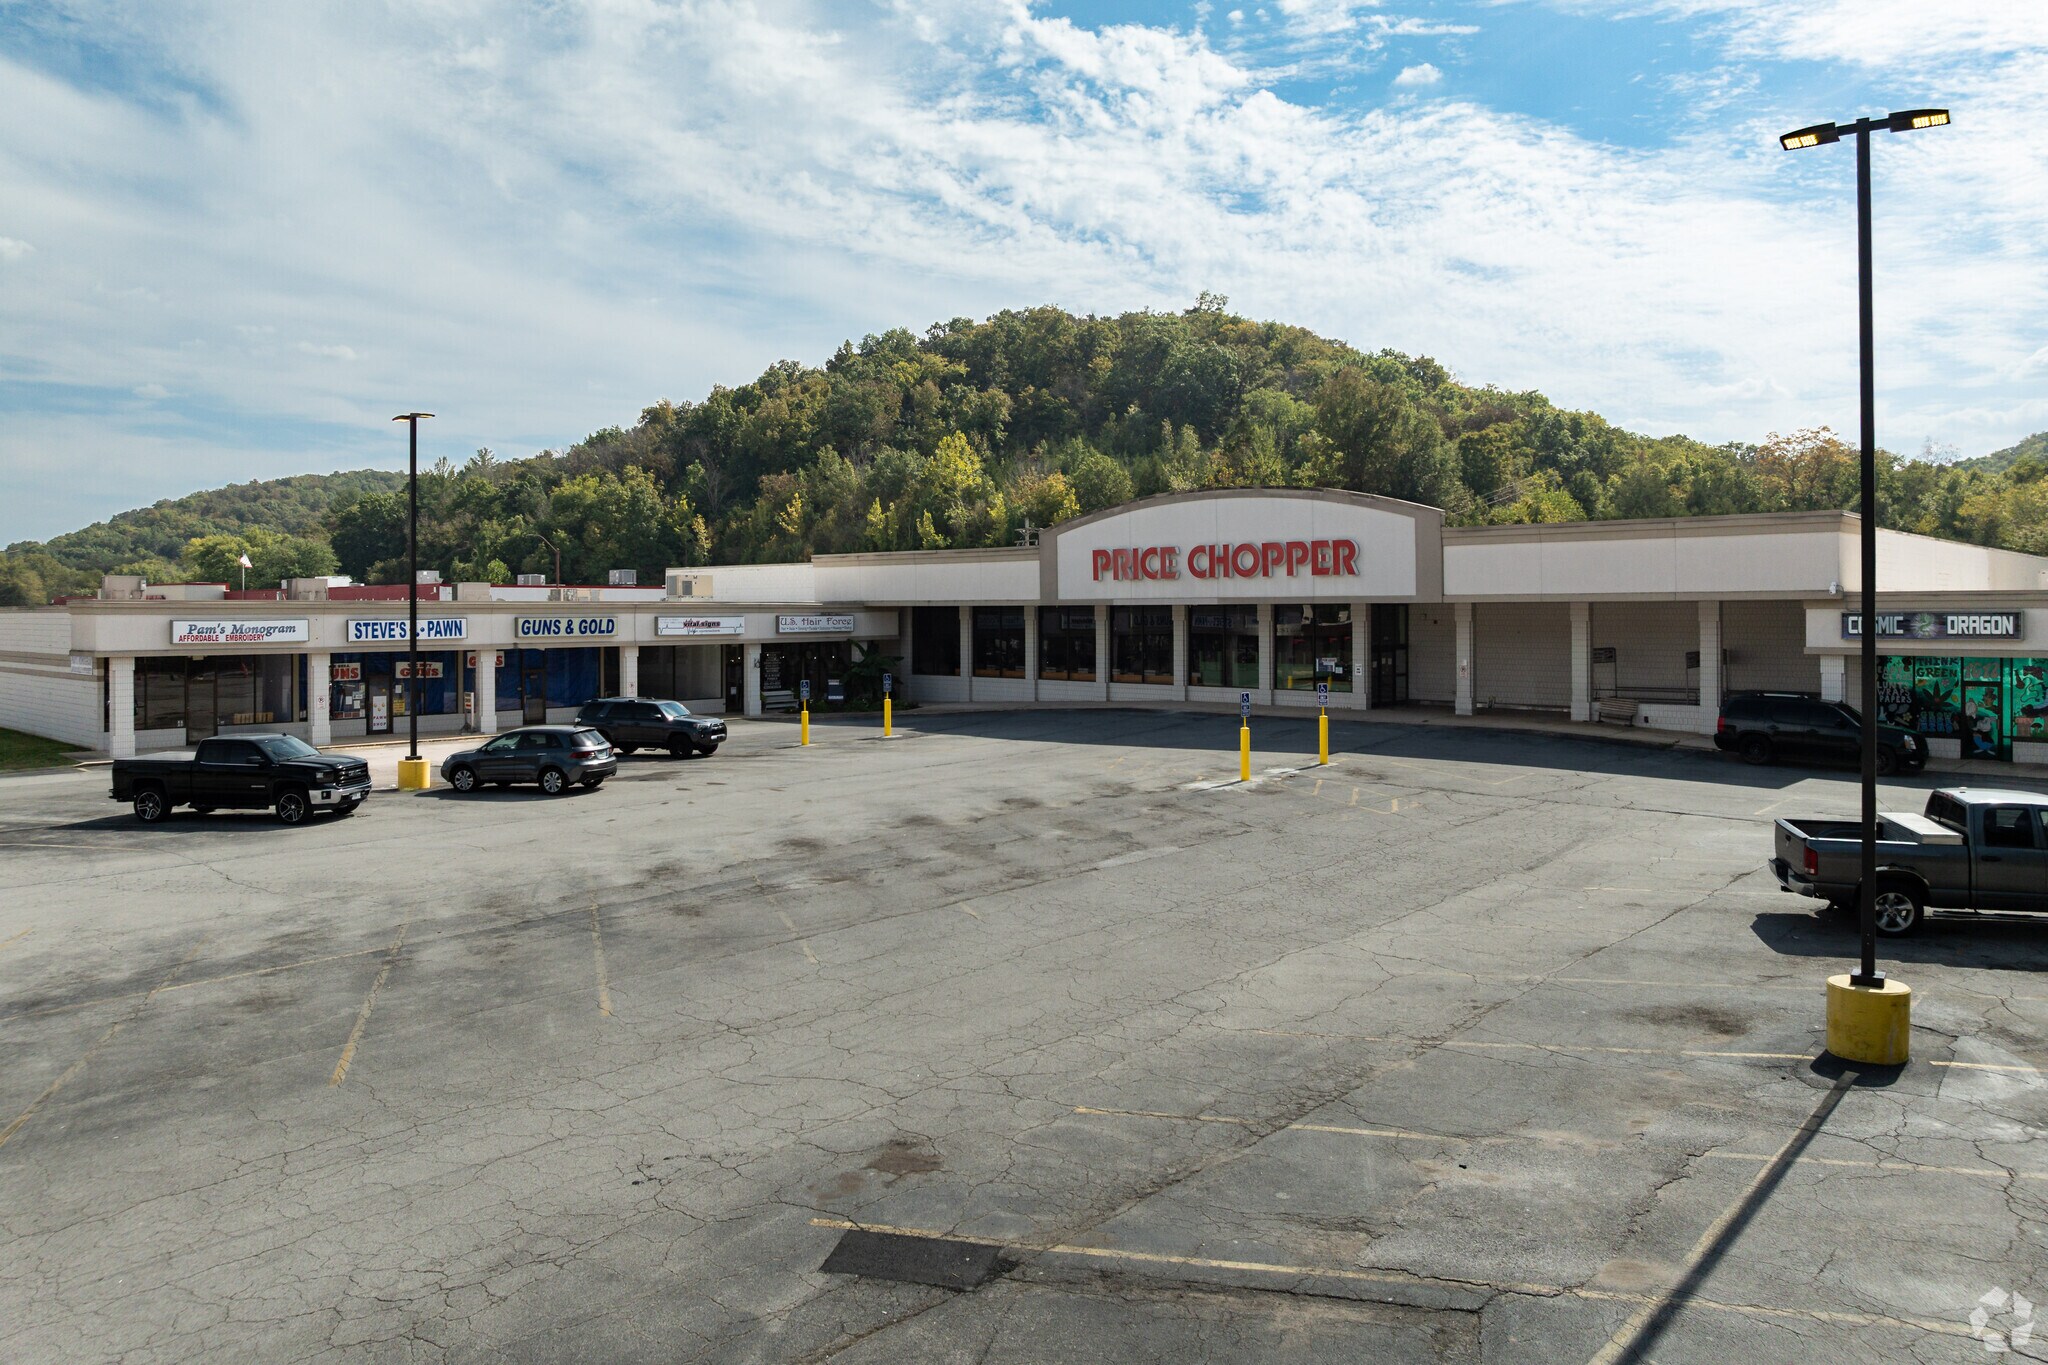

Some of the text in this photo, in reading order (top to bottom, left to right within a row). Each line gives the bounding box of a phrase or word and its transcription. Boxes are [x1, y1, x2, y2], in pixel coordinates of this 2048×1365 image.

[1091, 539, 1361, 582] PRICE CHOPPER
[521, 618, 615, 635] GUNS & GOLD
[780, 617, 853, 626] U.S. Hair Force
[1847, 615, 2014, 635] CMIC DRAGON
[187, 623, 297, 637] Pam's Monogram
[354, 620, 463, 640] STEVE'S PAWN
[178, 633, 265, 643] AFFORDABLE EMBROIDERY
[1916, 657, 1960, 666] THINK
[1916, 667, 1958, 678] GREEN
[1877, 688, 1912, 697] WRAPS
[1879, 695, 1913, 704] PAPERS
